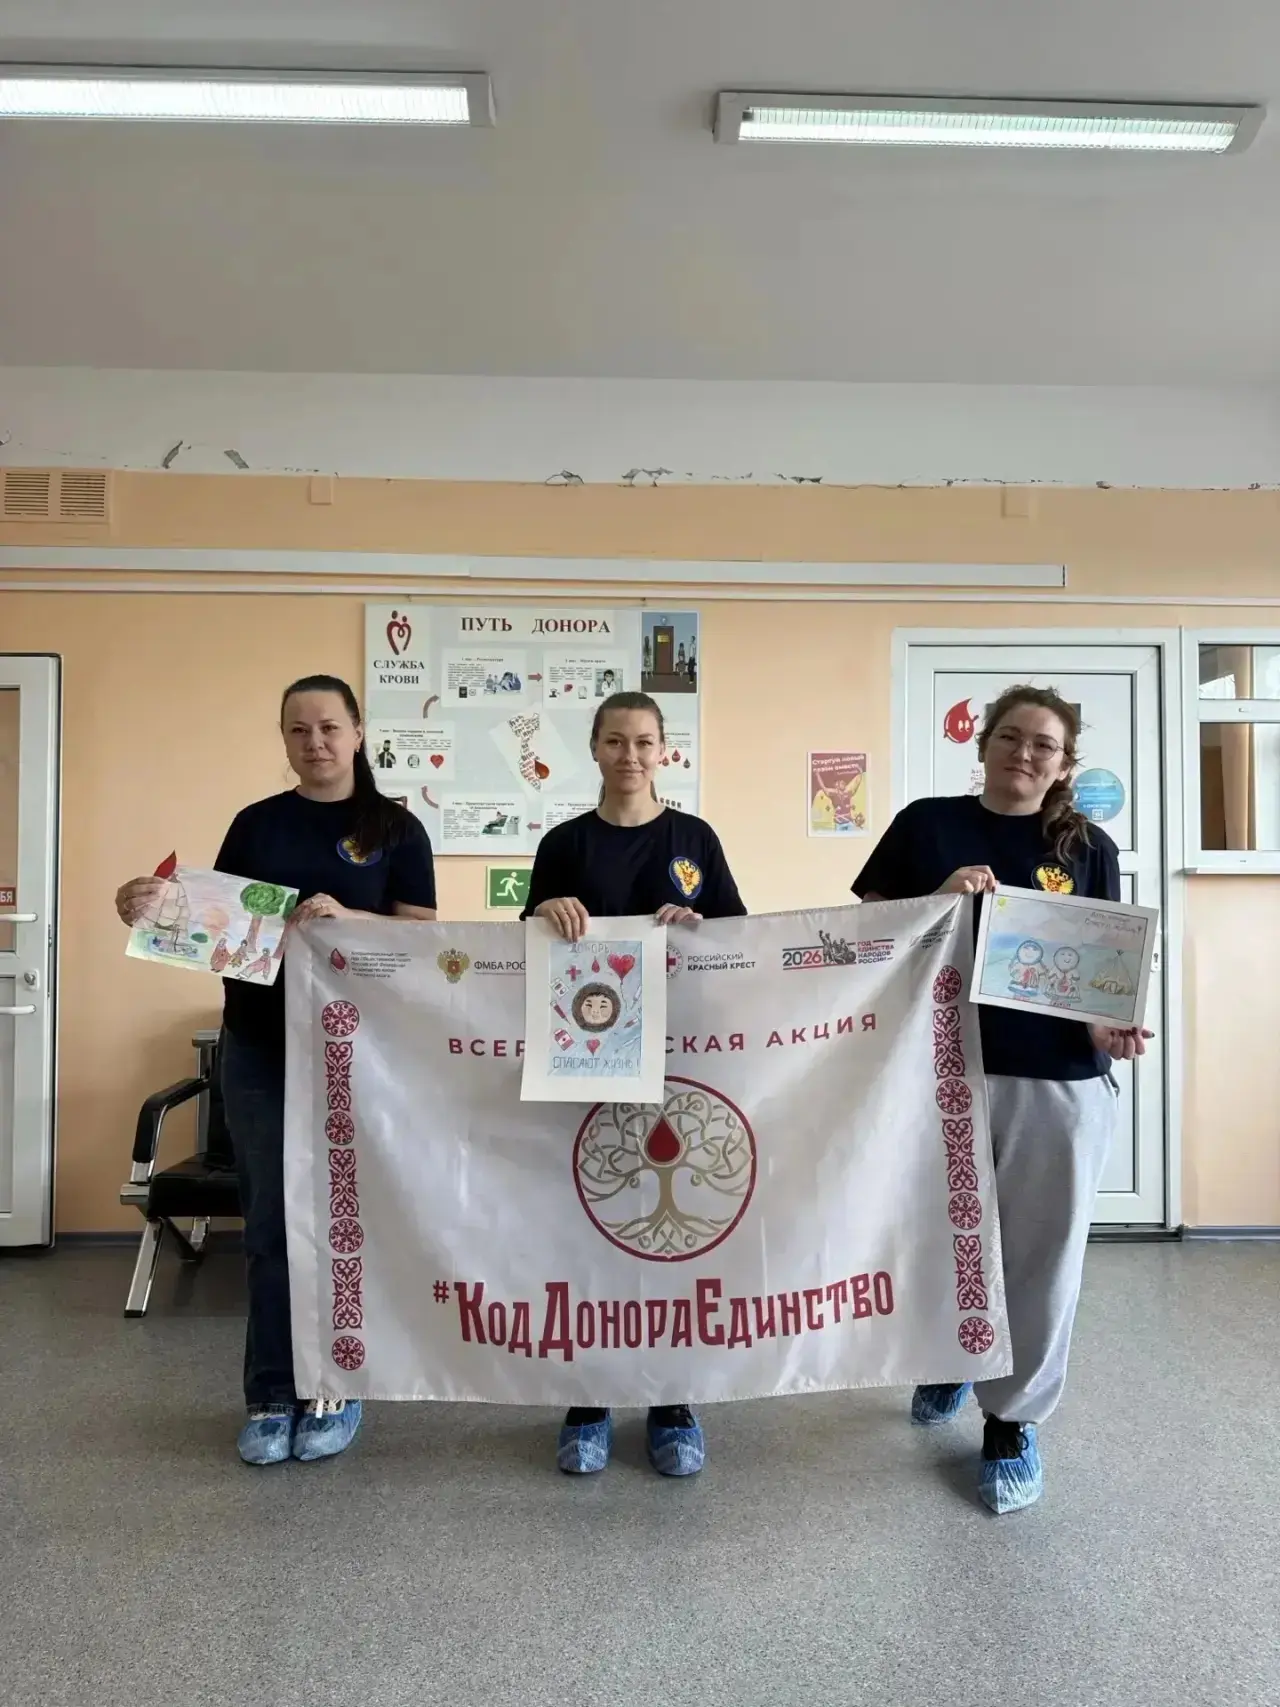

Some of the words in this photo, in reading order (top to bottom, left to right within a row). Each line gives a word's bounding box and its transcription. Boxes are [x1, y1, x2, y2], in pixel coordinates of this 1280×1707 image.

[461, 617, 513, 632] ПУТЬ
[531, 618, 611, 635] ДОНОРА
[373, 660, 425, 671] СЛУЖБА
[379, 675, 419, 685] КРОВИ
[0, 890, 13, 903] БЯ
[857, 940, 872, 948] ГОД
[687, 952, 744, 964] РОССИЙСКИЙ
[782, 950, 822, 967] 2026
[858, 951, 891, 959] НАРОДОВ
[474, 961, 504, 970] ФМБА
[506, 961, 526, 971] РОС
[687, 962, 728, 972] КРАСНЫЙ
[730, 961, 756, 970] КРЕСТ
[766, 1013, 876, 1048] АКЦИЯ
